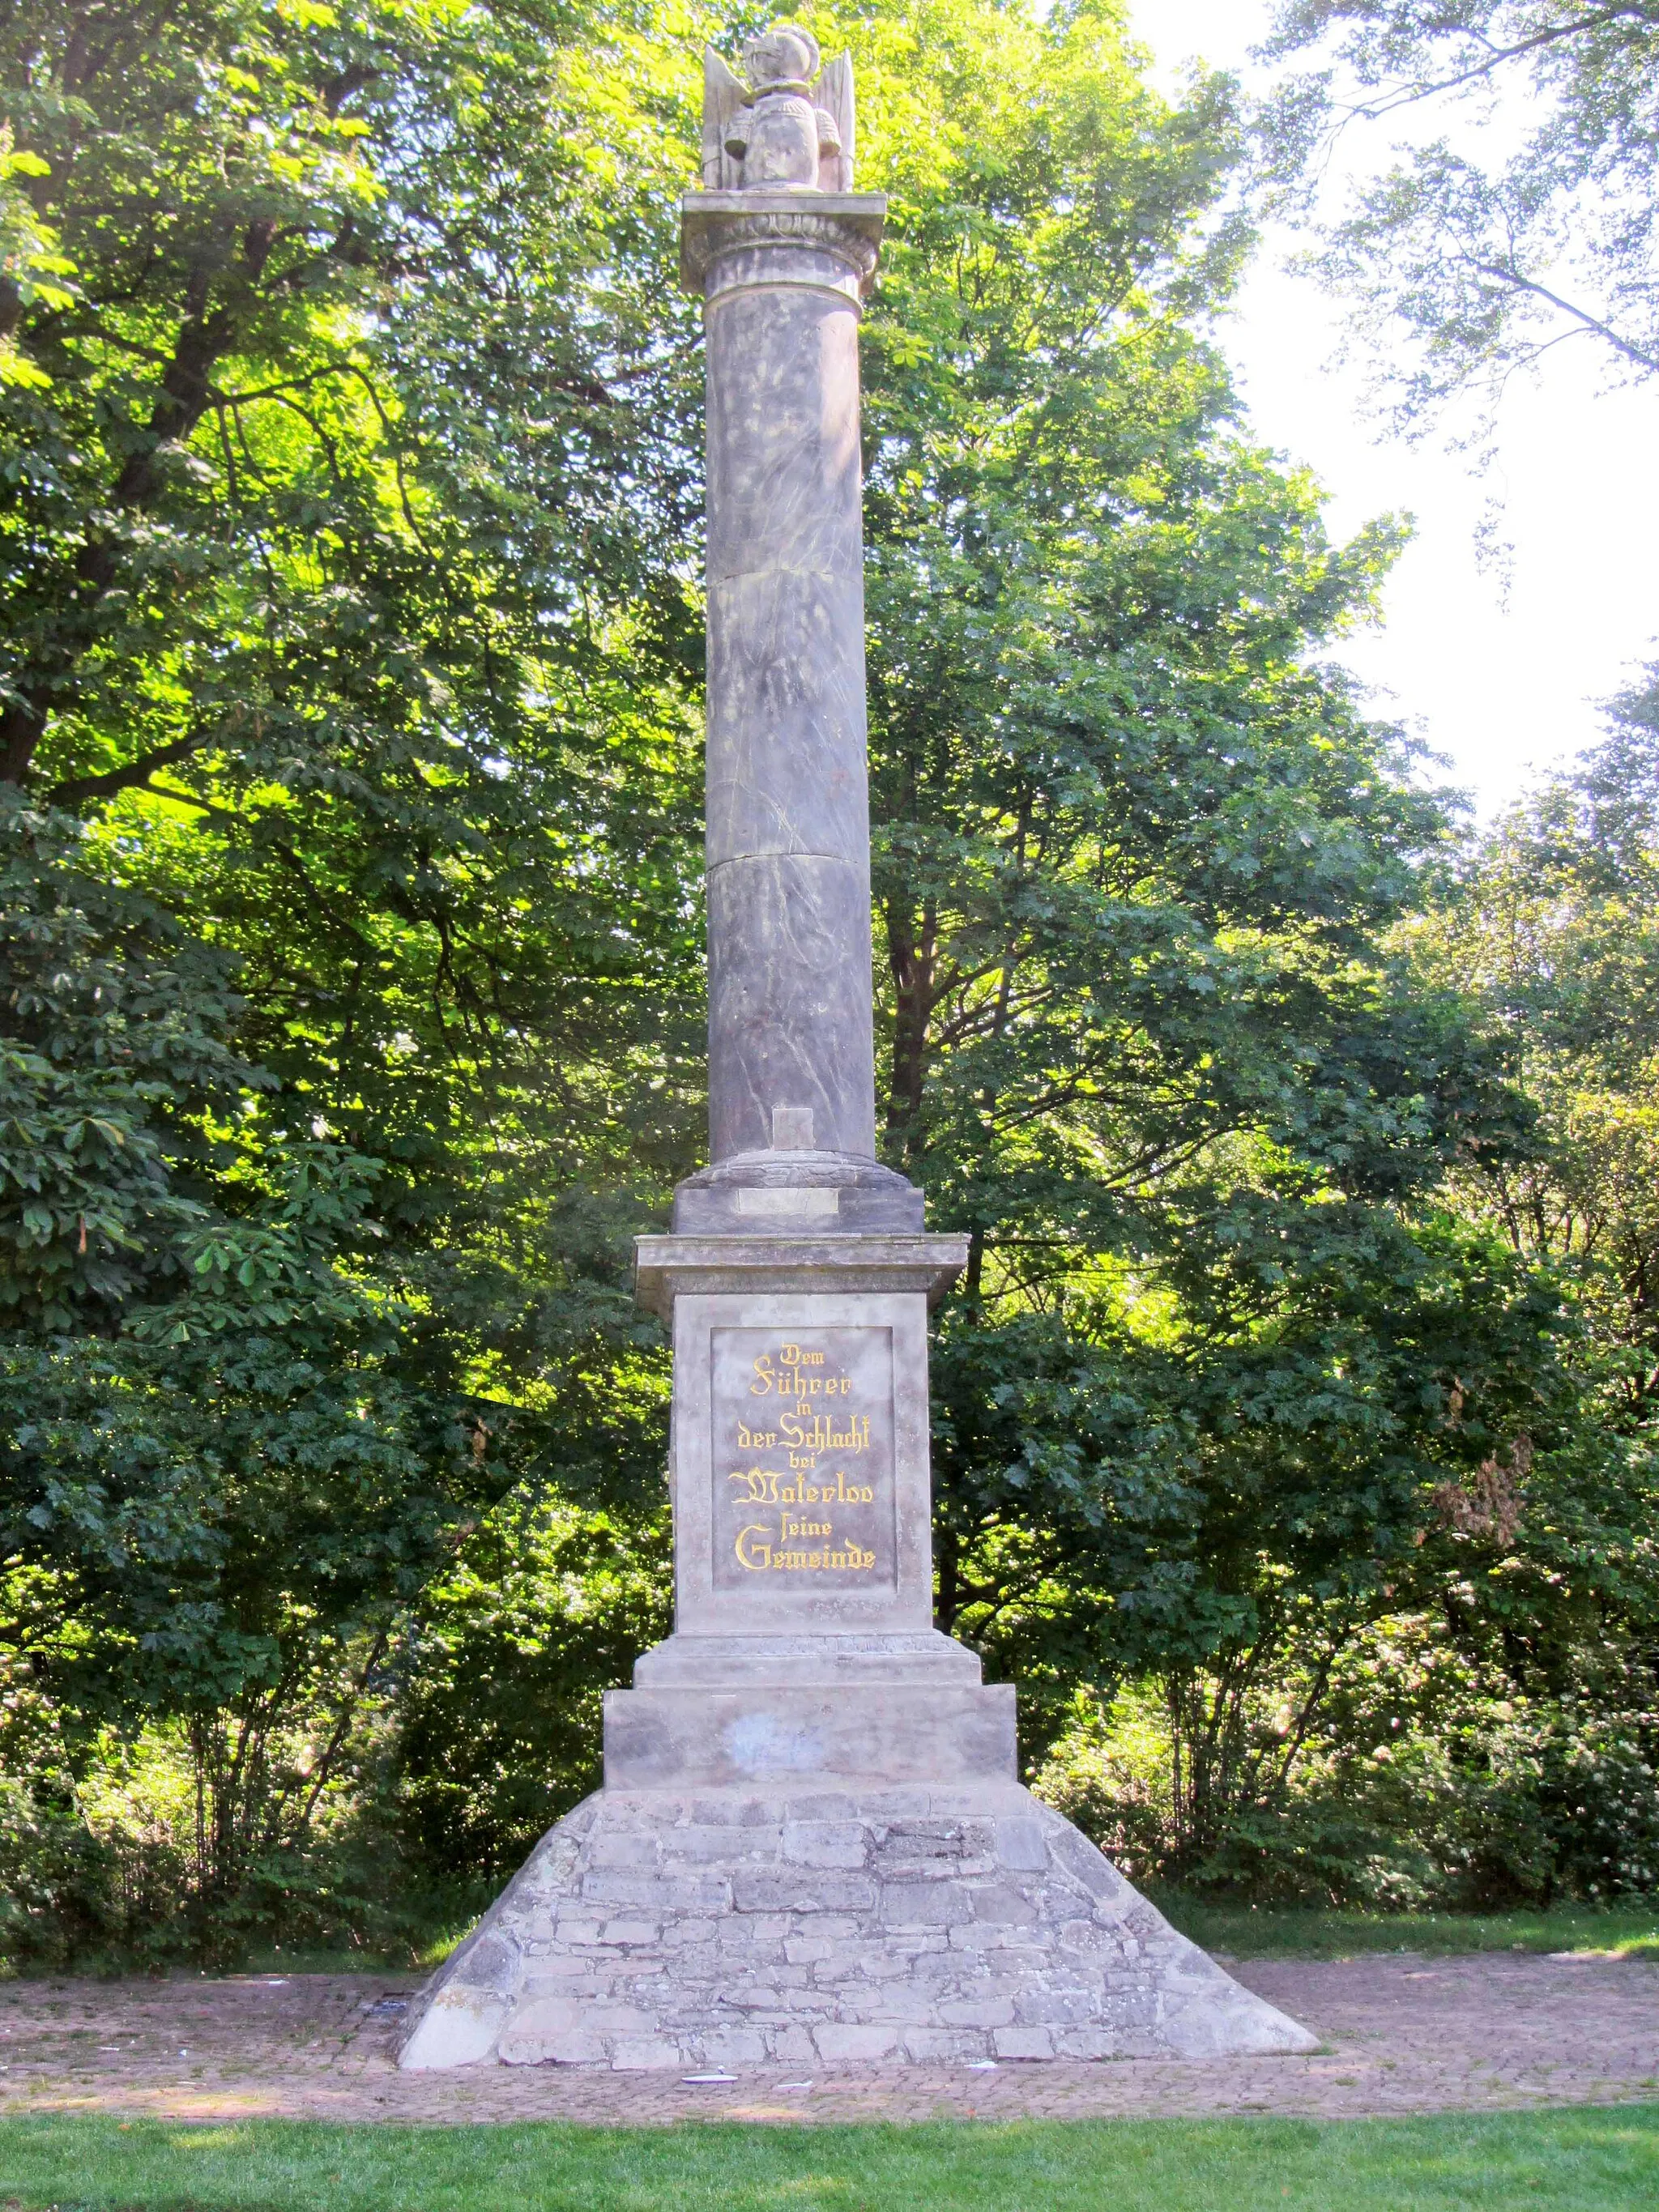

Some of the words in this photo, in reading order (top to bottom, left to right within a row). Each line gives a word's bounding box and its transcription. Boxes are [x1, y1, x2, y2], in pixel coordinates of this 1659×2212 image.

[780, 1341, 825, 1366] Dem
[750, 1354, 851, 1400] Führer
[796, 1400, 812, 1416] in
[737, 1420, 777, 1448] der
[778, 1412, 872, 1455] Schlacht
[789, 1450, 817, 1468] bei
[728, 1466, 874, 1504] Waterloo
[735, 1524, 876, 1570] Gemeinde
